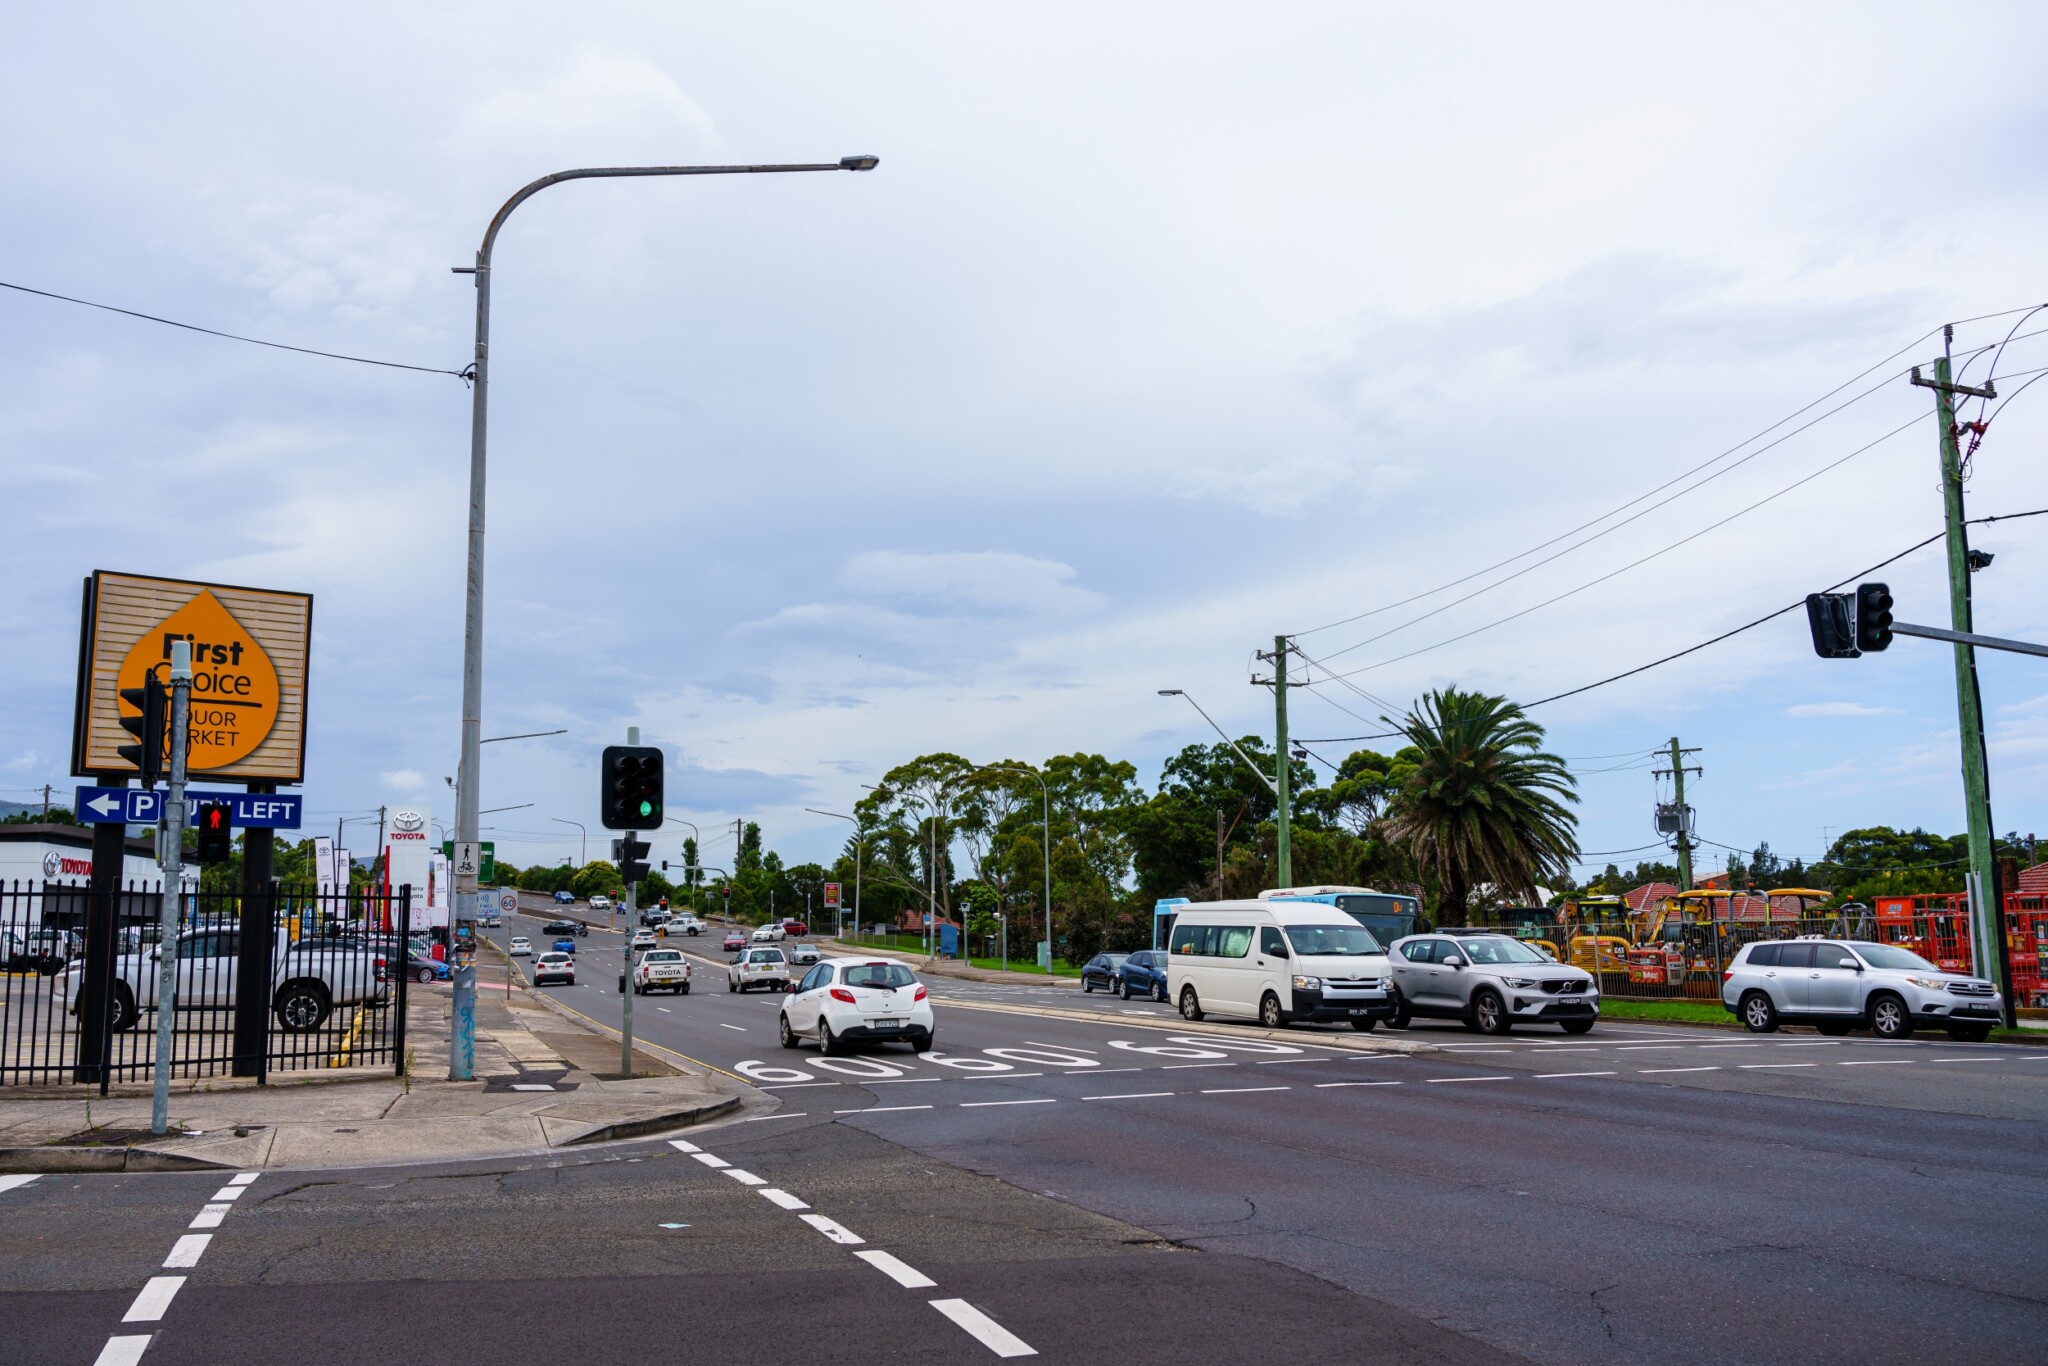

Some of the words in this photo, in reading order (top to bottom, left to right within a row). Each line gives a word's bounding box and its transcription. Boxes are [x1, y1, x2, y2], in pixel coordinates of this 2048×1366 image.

[153, 662, 251, 696] Coice
[239, 801, 295, 820] LEFT
[60, 858, 93, 876] TOYOTA
[503, 899, 515, 907] 60
[1107, 1037, 1304, 1059] 60
[734, 1057, 904, 1082] 60
[918, 1048, 1101, 1071] 60
